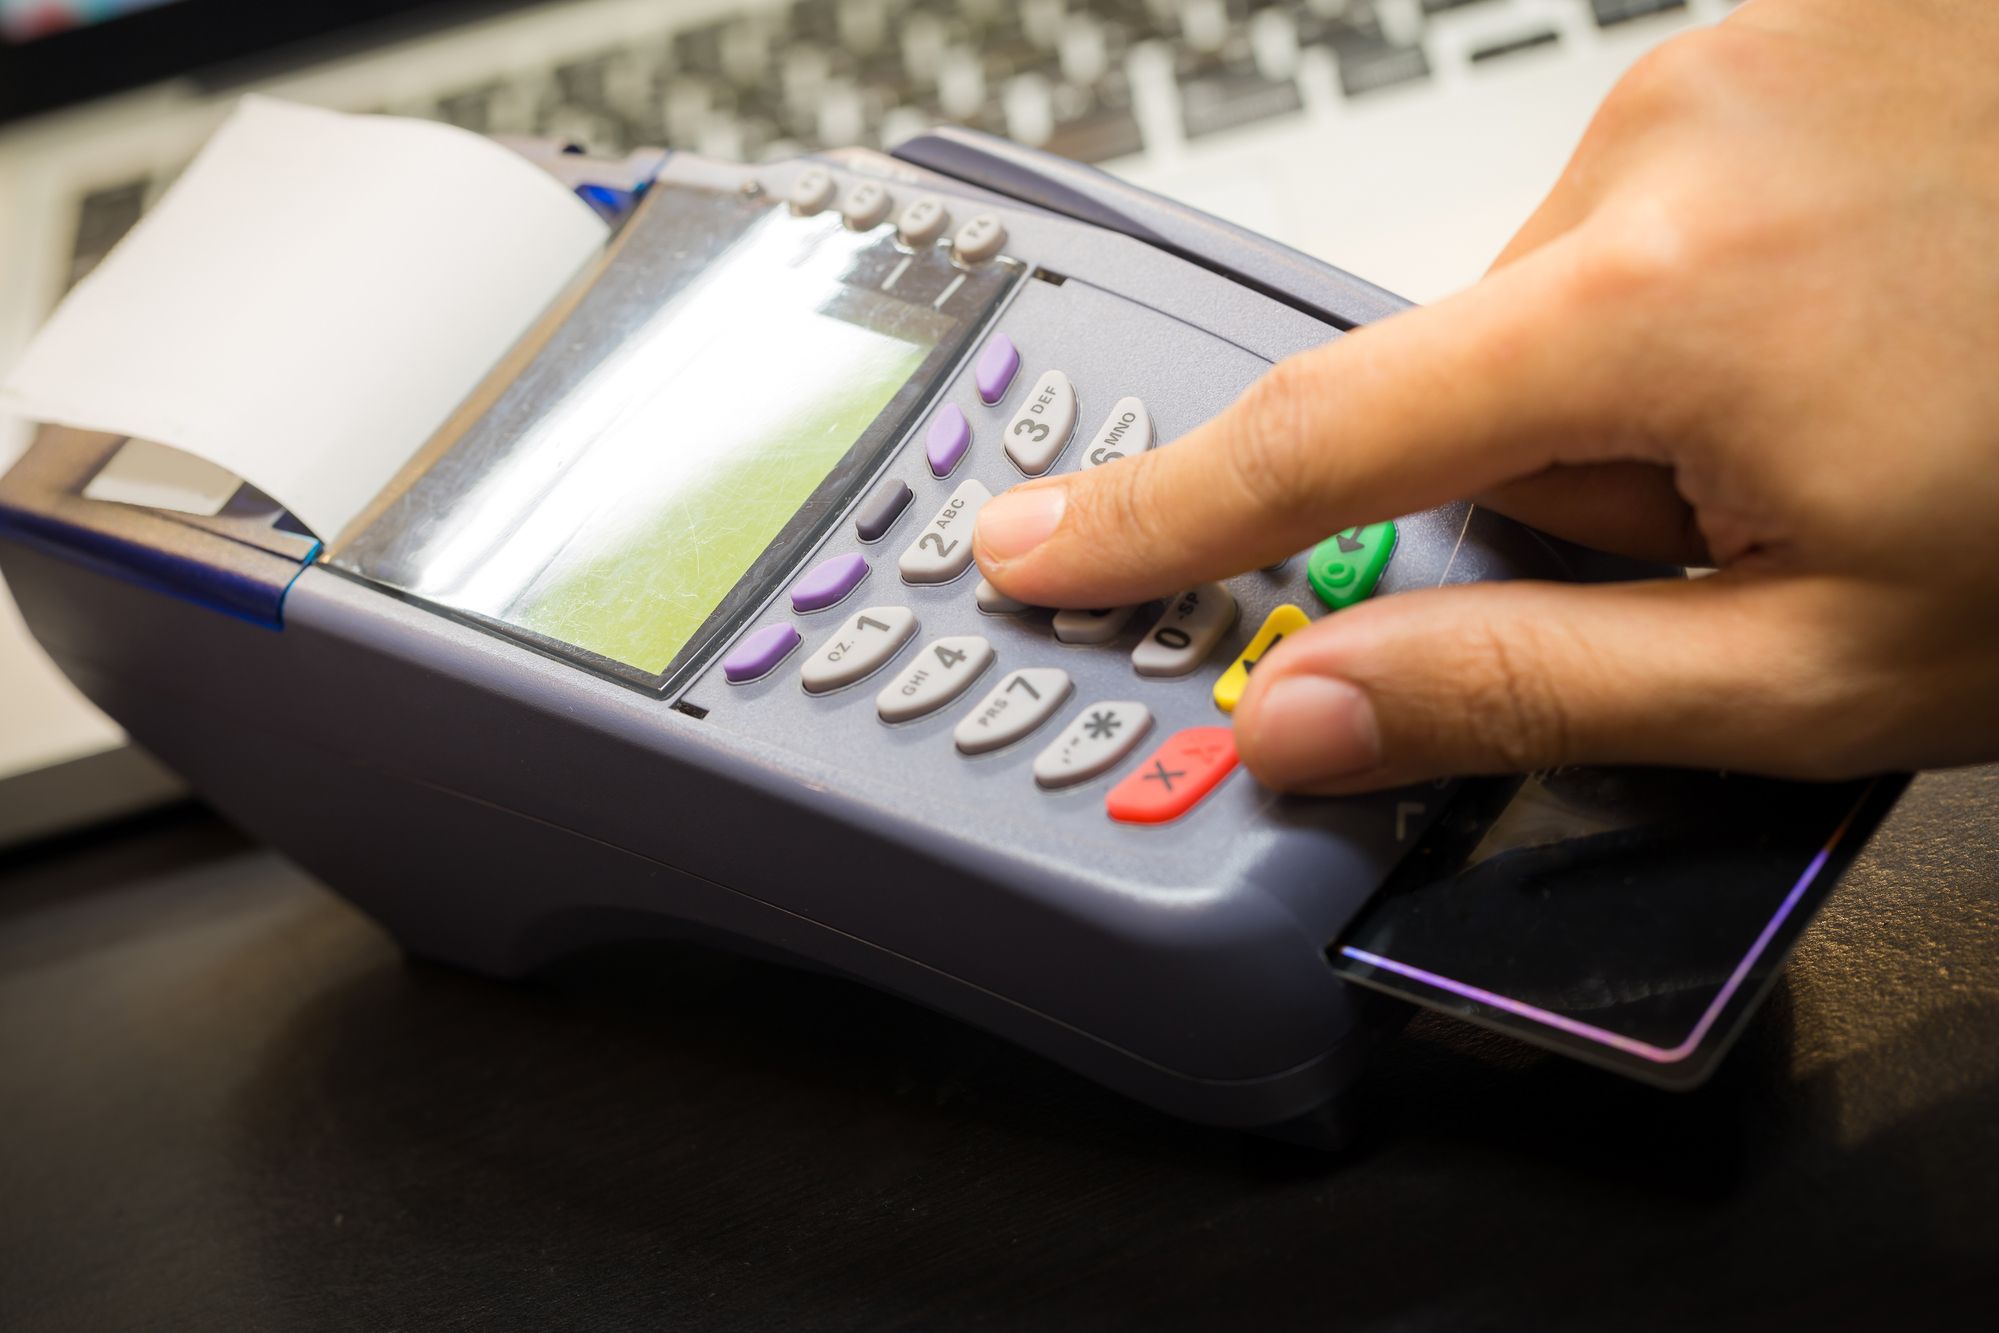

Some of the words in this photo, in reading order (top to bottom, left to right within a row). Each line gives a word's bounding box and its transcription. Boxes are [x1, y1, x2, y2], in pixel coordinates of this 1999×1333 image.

[1030, 385, 1056, 414] DEF
[1013, 418, 1050, 443] 3
[1104, 412, 1136, 446] MNO
[936, 498, 965, 529] ABC
[919, 533, 959, 558] 2
[856, 615, 891, 632] 1
[1154, 627, 1191, 649] 0
[901, 670, 930, 696] GHI
[933, 645, 967, 669] 4
[978, 700, 1009, 727] PRS
[1006, 676, 1041, 701] 7
